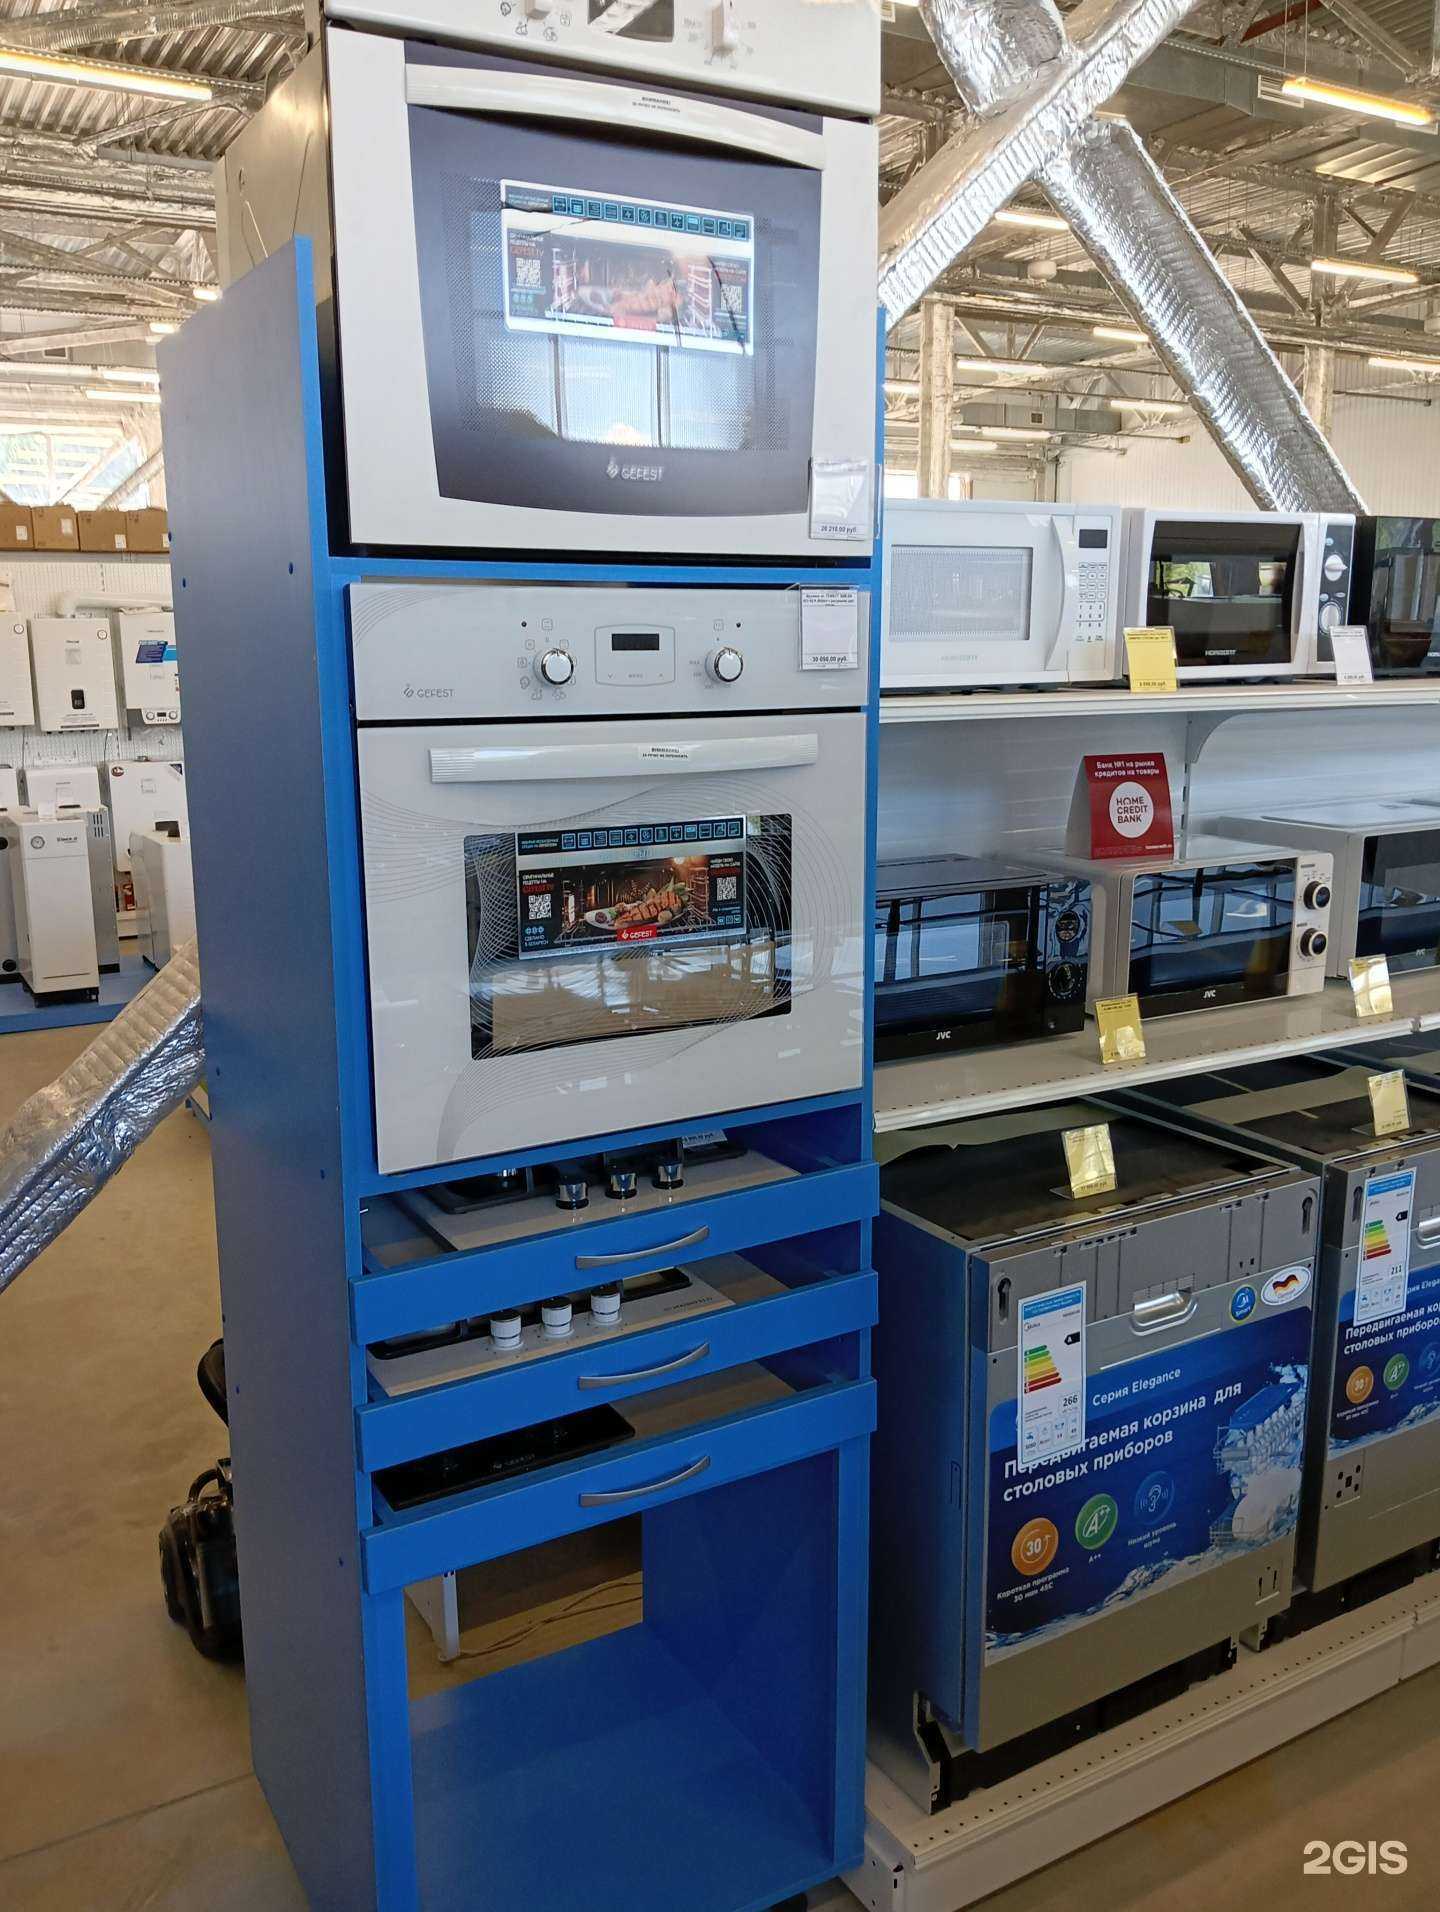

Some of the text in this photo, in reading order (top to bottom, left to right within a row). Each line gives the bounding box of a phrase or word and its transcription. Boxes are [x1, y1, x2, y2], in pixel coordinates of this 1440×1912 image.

[621, 464, 664, 481] GEFEST
[417, 688, 456, 698] GEFEST
[1116, 796, 1145, 806] HOME
[1117, 805, 1148, 815] CREDIT
[1118, 814, 1142, 824] BANK
[629, 929, 652, 939] GEFEST
[1203, 990, 1216, 999] JVC
[936, 1031, 951, 1040] JVC
[1345, 1307, 1425, 1340] Передвигаемая
[1344, 1331, 1394, 1355] столовых
[1092, 1366, 1181, 1406] Серия Elegance
[1063, 1394, 1079, 1407] 266
[1143, 1395, 1206, 1428] корзина
[1214, 1382, 1242, 1405] для
[1003, 1430, 1173, 1502] столовых приборов
[1026, 1538, 1042, 1557] 30
